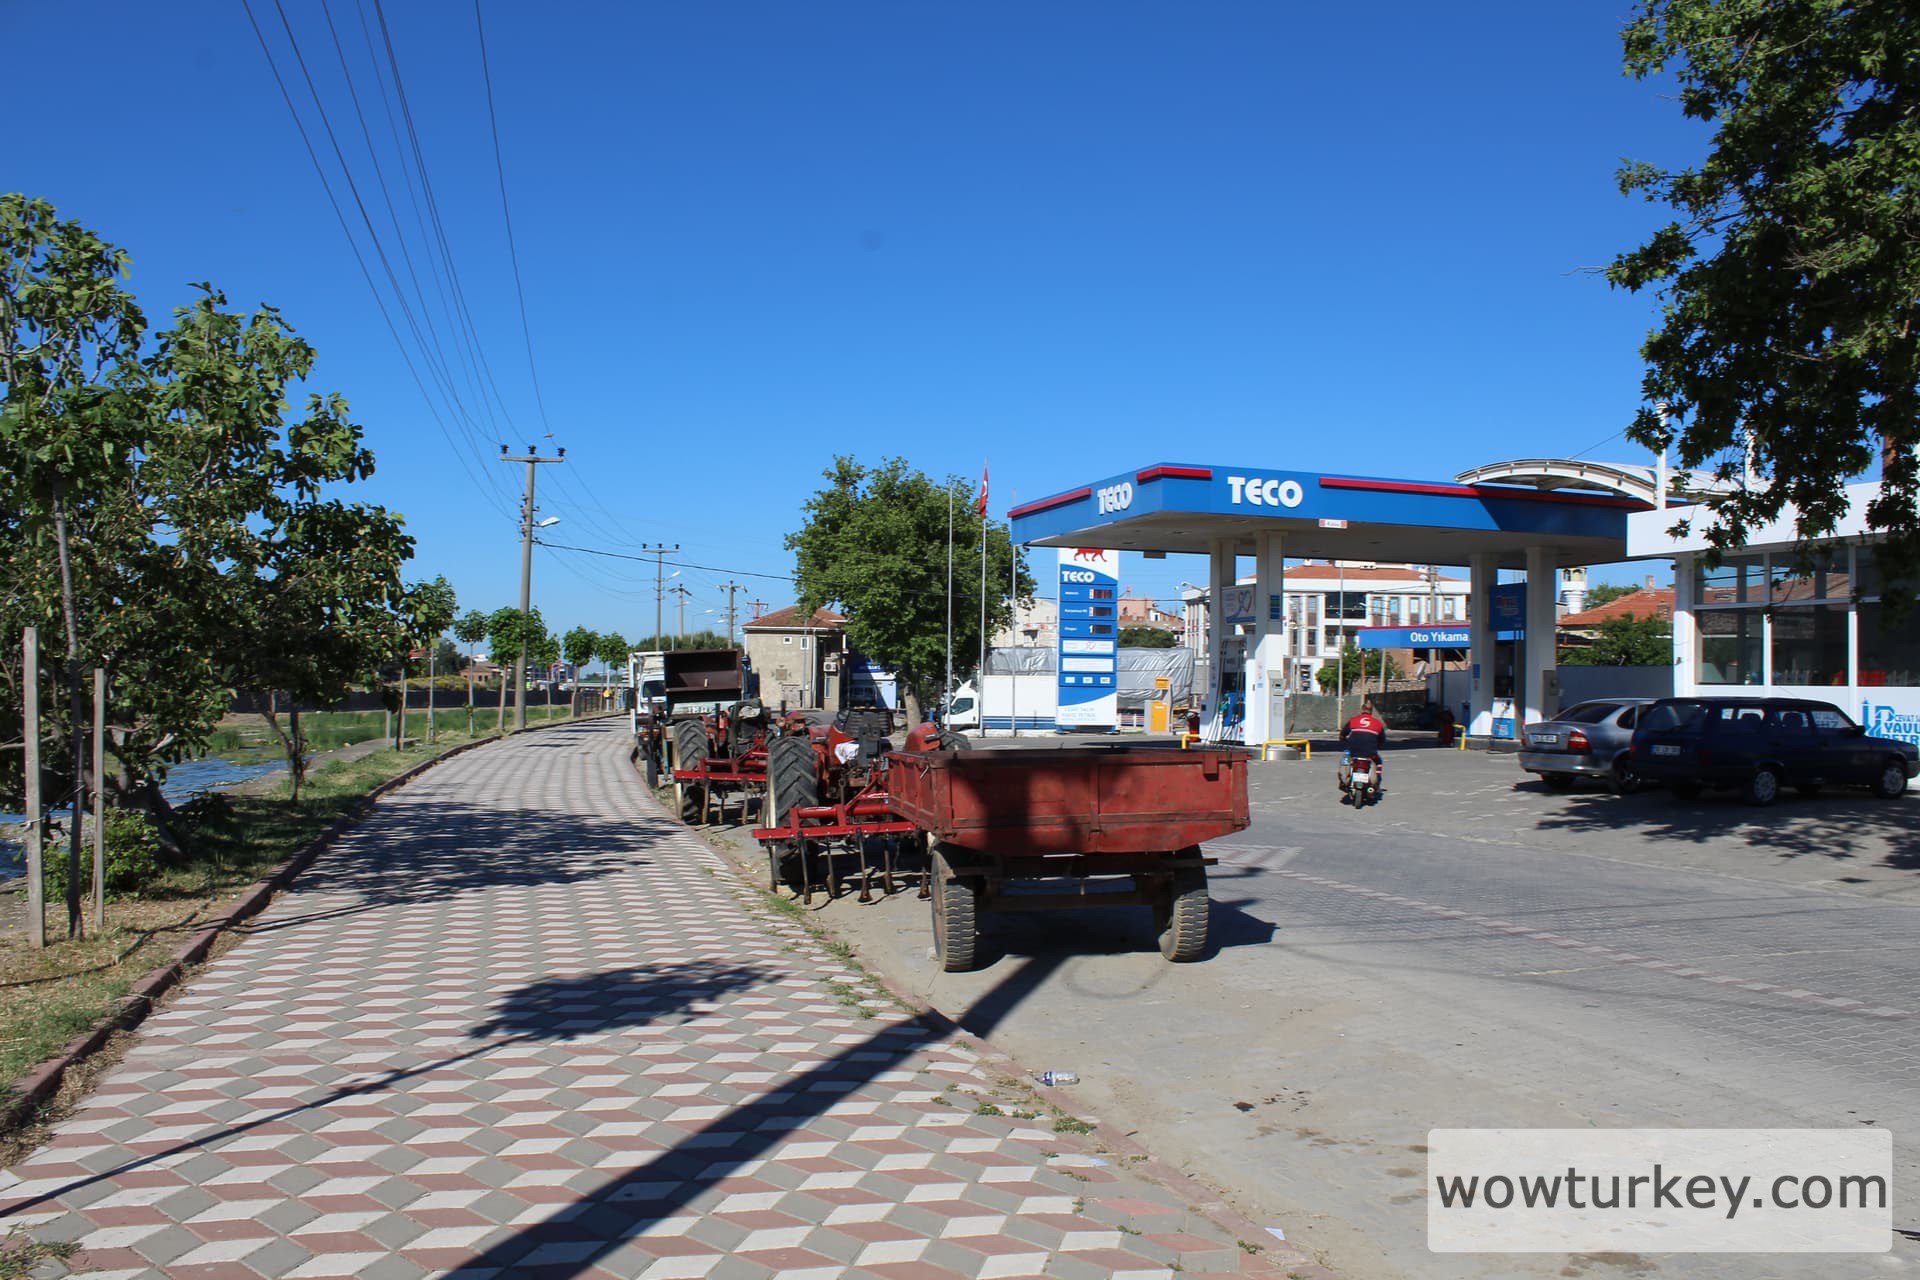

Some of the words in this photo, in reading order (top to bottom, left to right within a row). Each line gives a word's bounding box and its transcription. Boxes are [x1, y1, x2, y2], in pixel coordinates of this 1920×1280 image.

[1096, 482, 1133, 515] TECO
[1227, 476, 1304, 508] TECO
[1062, 571, 1095, 583] TECO
[1410, 631, 1429, 642] Oto
